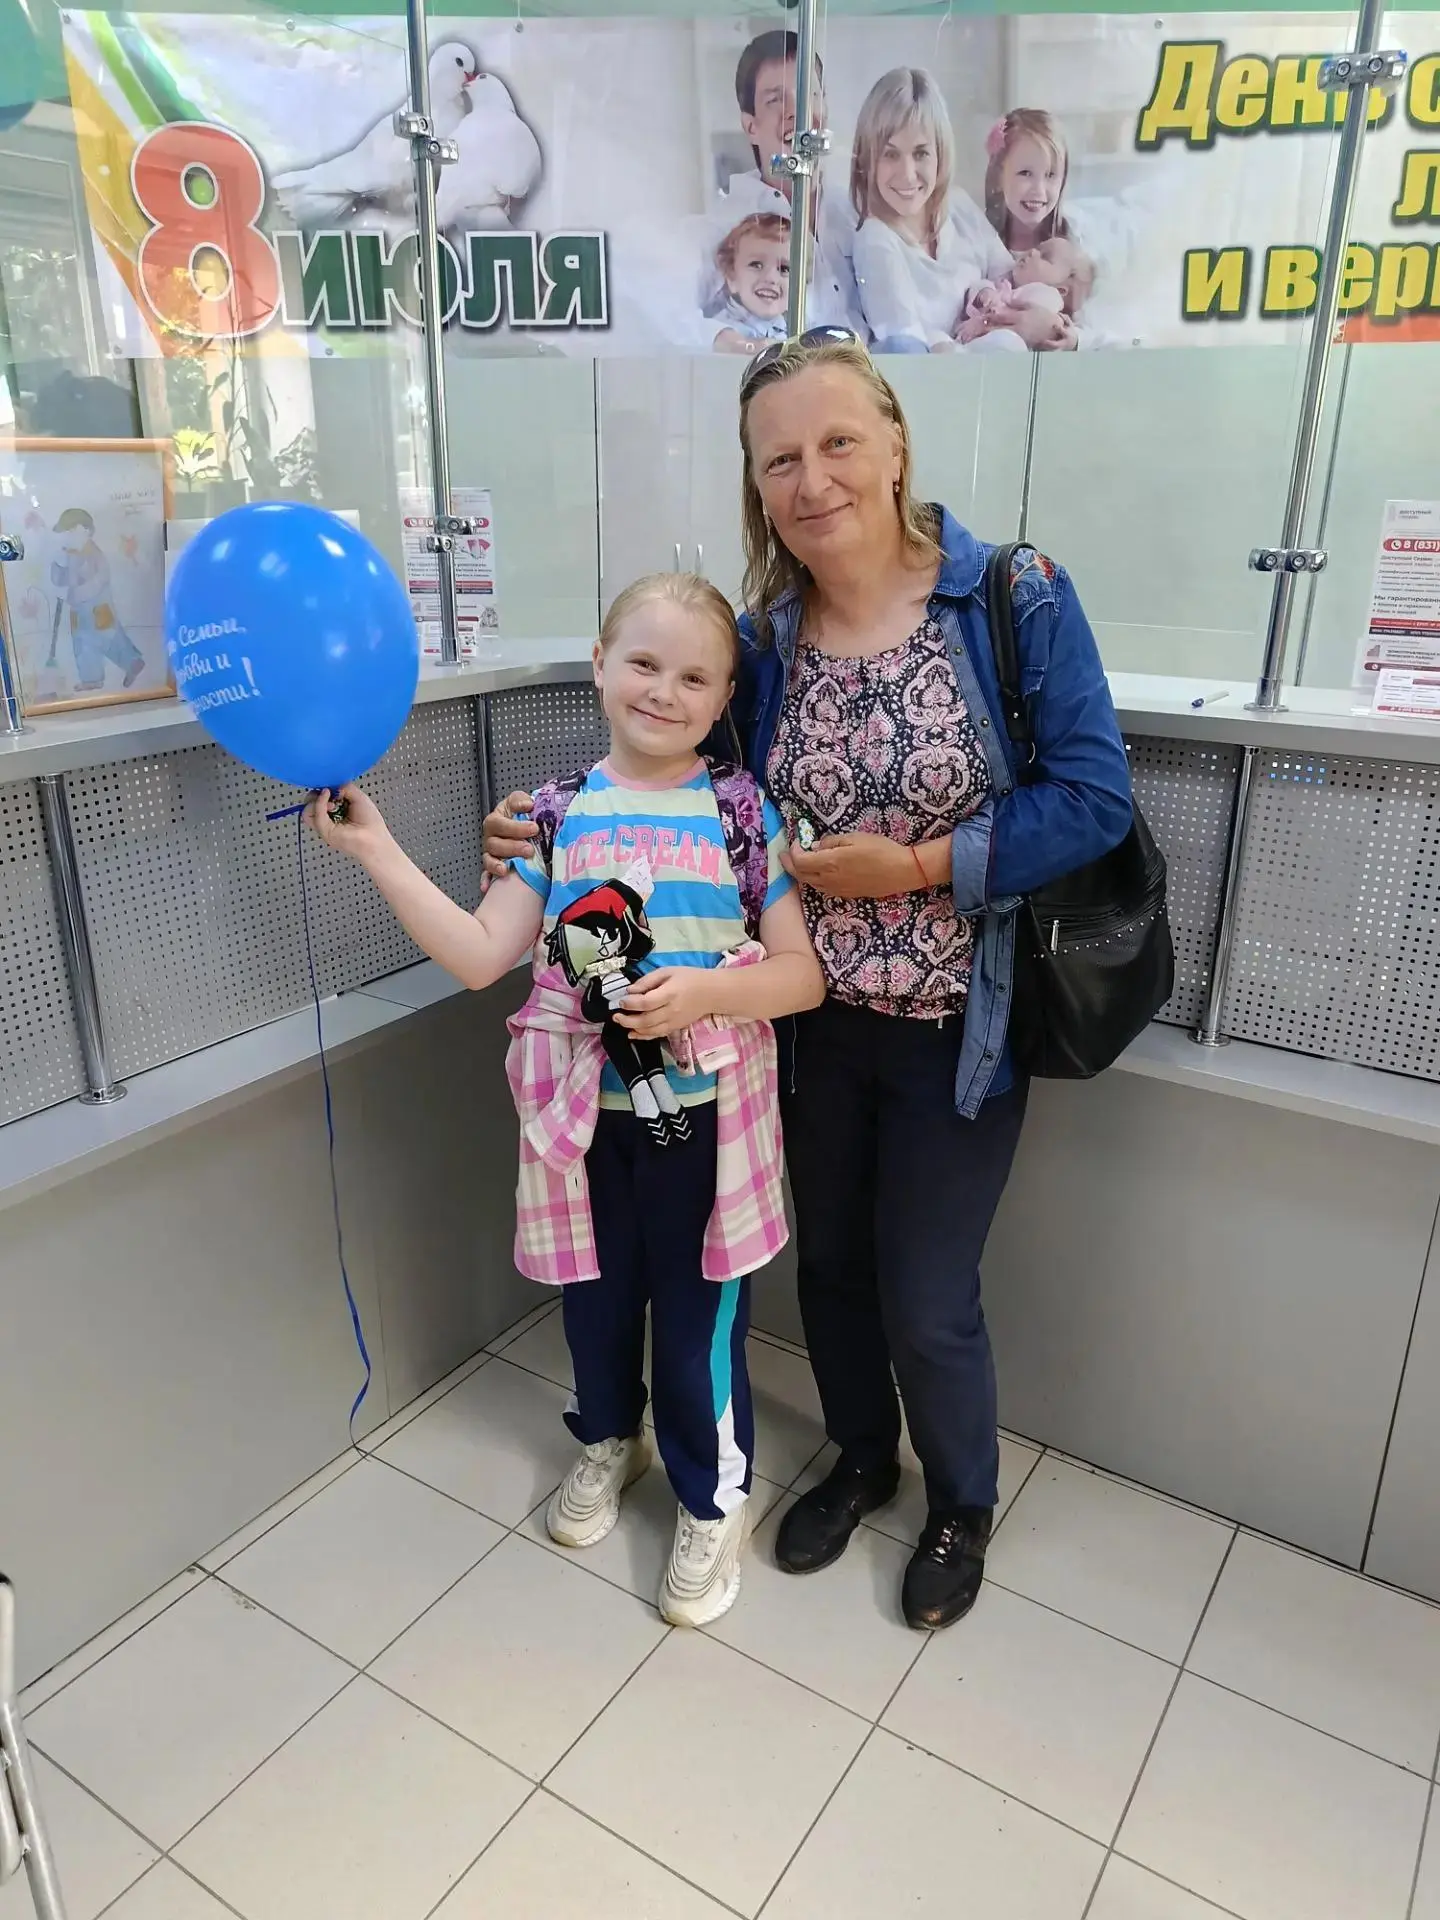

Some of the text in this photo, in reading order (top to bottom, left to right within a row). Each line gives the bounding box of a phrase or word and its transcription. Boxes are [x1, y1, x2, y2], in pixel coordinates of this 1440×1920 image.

[130, 119, 283, 340] 8
[1184, 244, 1440, 322] и вер
[1403, 540, 1440, 552] 8 (831)
[562, 824, 722, 889] ICE CREAM
